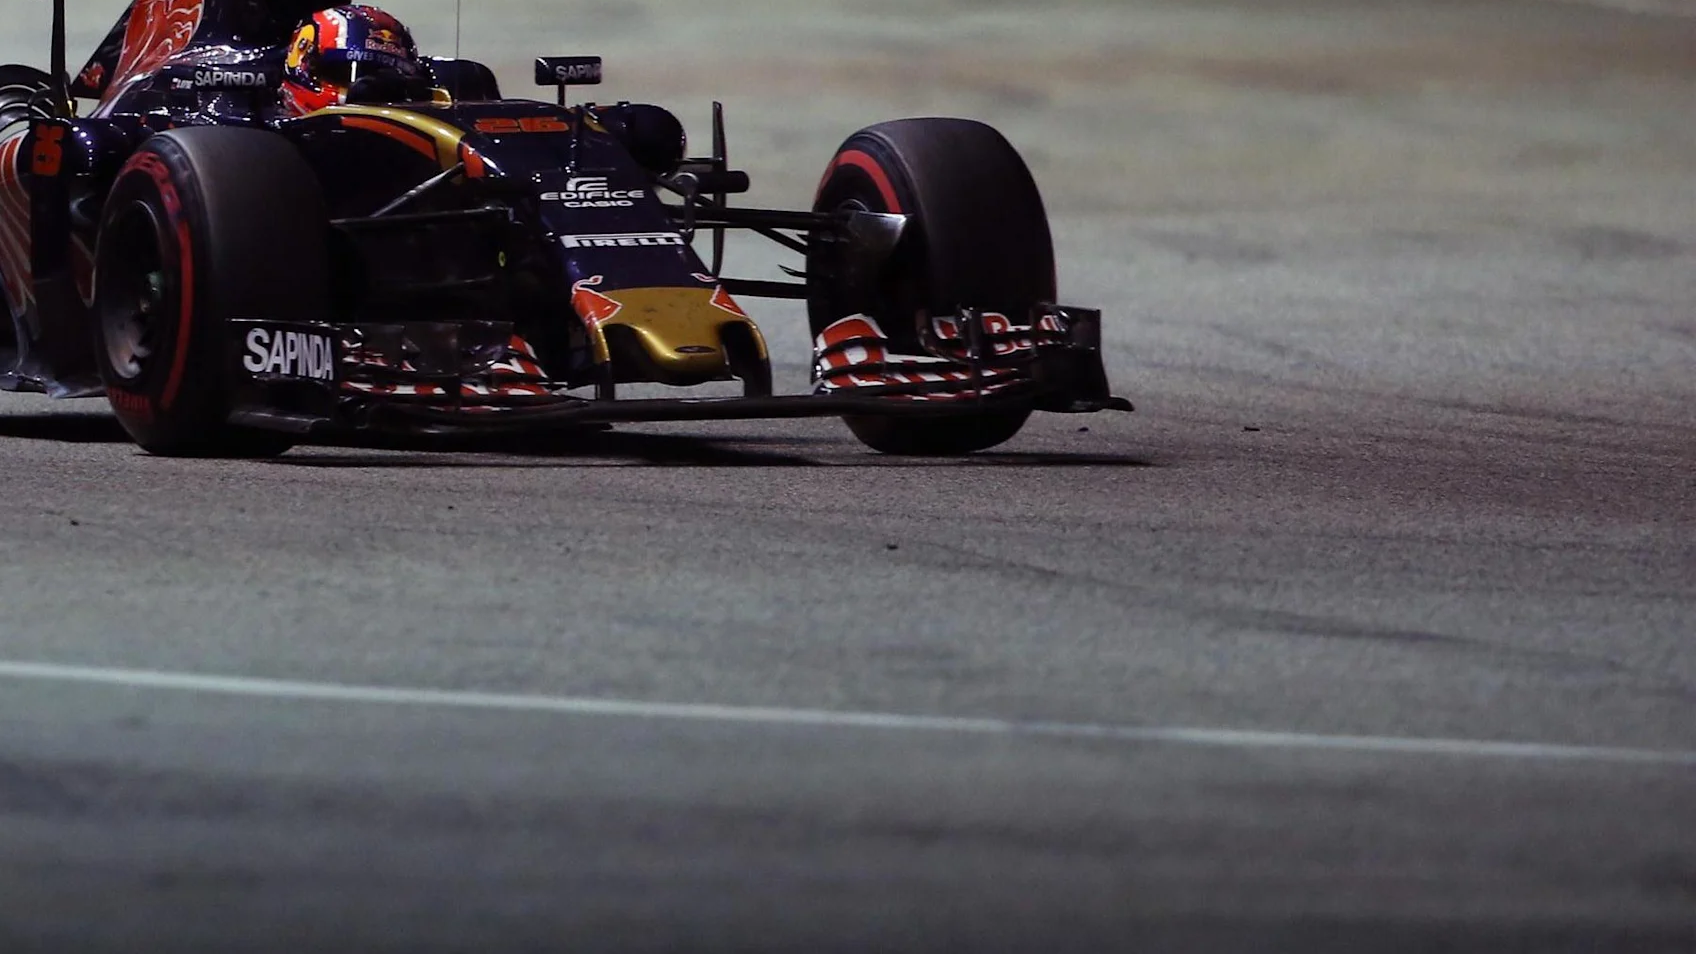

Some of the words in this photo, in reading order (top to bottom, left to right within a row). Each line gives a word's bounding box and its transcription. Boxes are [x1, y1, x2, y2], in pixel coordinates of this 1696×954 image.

[194, 70, 267, 87] SAPINDA
[474, 117, 570, 133] 26
[540, 190, 645, 201] EDIFICE
[563, 200, 635, 208] CASIO
[559, 232, 686, 249] PIRELLI
[242, 327, 334, 381] SAPINDA
